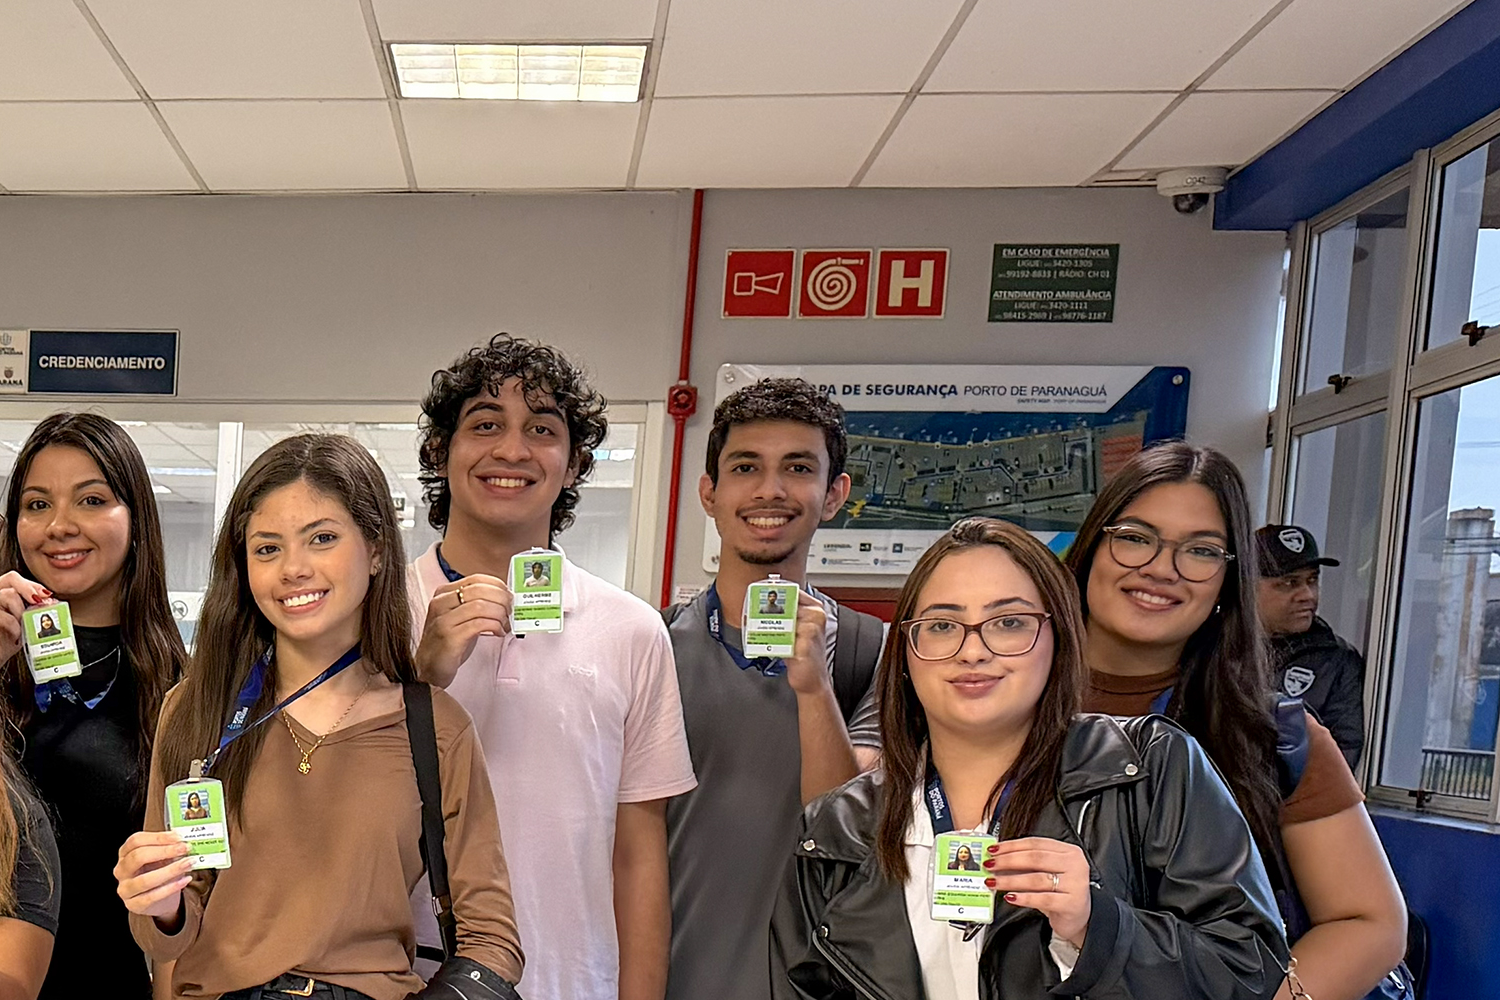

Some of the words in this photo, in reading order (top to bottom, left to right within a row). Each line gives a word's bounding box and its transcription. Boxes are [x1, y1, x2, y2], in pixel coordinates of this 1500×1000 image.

[1002, 248, 1016, 258] EM
[1018, 248, 1041, 258] CASO
[1042, 248, 1054, 258] DE
[1055, 247, 1110, 258] EMERGÊNCIA
[888, 260, 934, 307] H
[993, 290, 1054, 300] ATENDIMENTO
[1055, 288, 1112, 300] AMBULÂNCIA
[38, 356, 166, 370] CREDENCIAMENTO
[842, 384, 861, 396] DE
[865, 384, 959, 398] SEGURANÇA
[963, 385, 1007, 396] PORTO
[1010, 385, 1028, 396] DE
[1031, 384, 1108, 396] PARANAGUÁ
[933, 787, 945, 810] PORTOS
